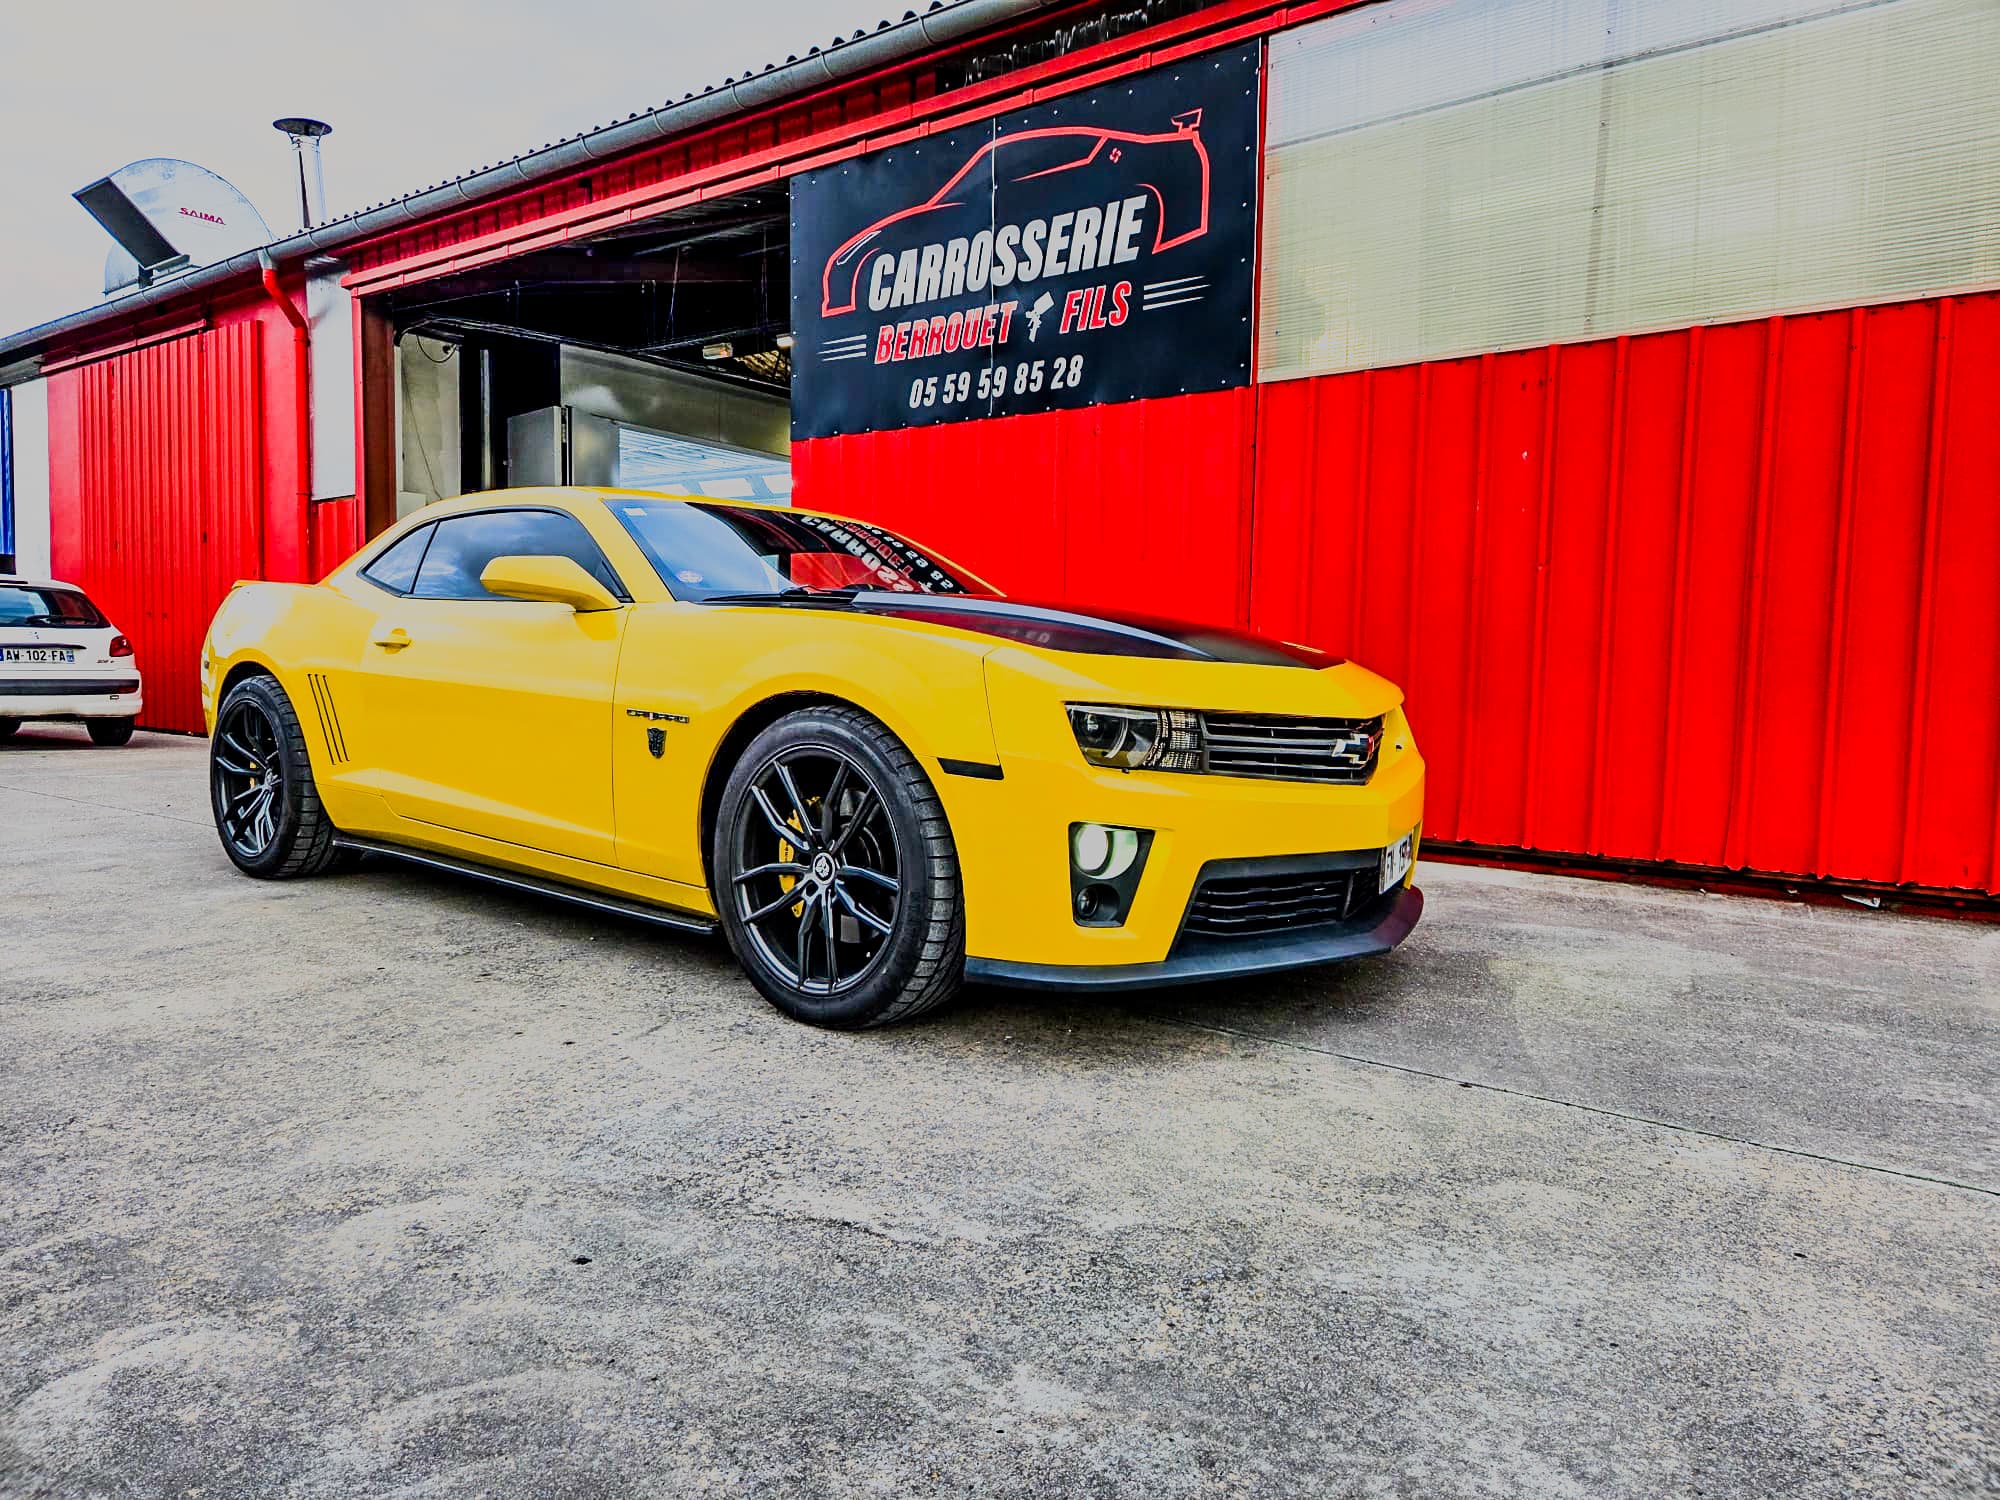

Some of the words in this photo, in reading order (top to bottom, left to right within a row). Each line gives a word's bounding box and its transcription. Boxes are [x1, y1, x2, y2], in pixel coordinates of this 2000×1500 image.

[178, 207, 226, 225] SAIMA
[868, 195, 1147, 311] CARROSSERIE
[874, 301, 1018, 364] BERROUET
[1059, 281, 1131, 334] FILS
[909, 377, 937, 408] 05
[943, 371, 970, 402] 59
[978, 366, 1007, 399] 59
[1014, 360, 1045, 394] 85
[1051, 355, 1083, 389] 28
[6, 650, 65, 661] AW-102-FA
